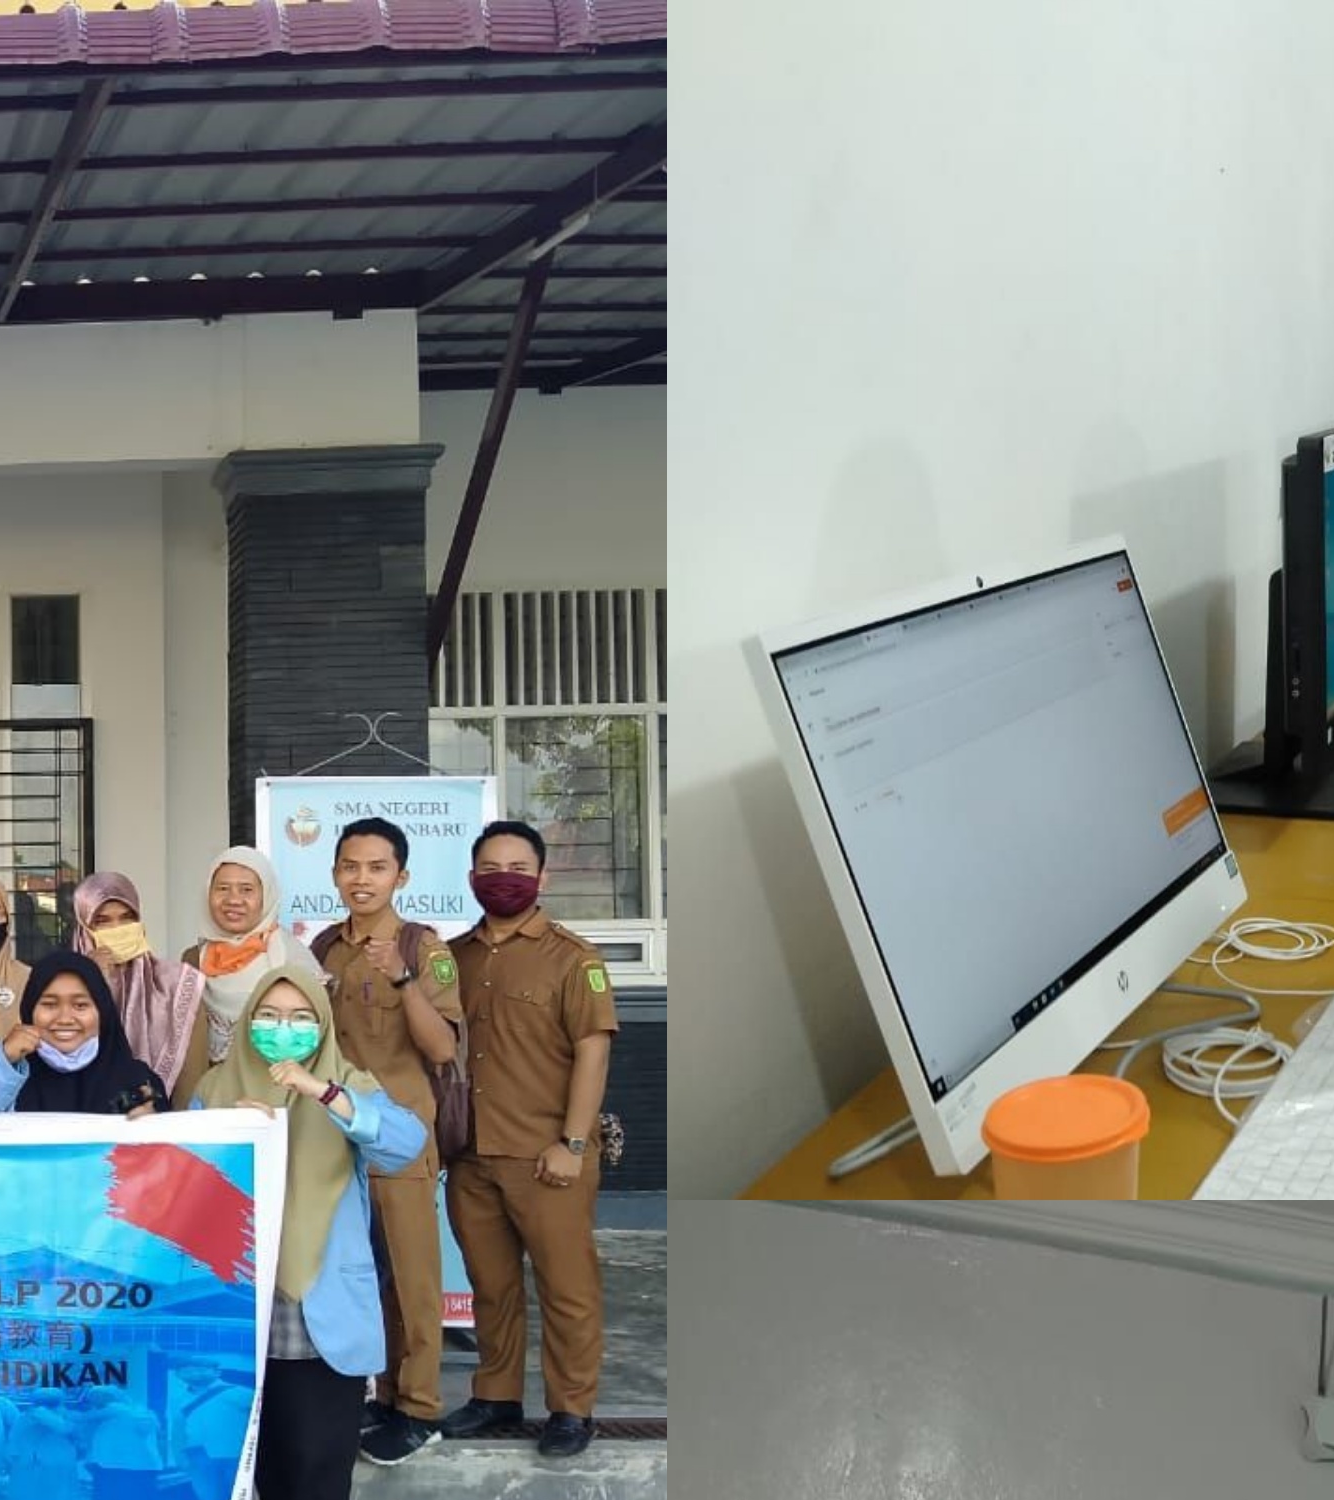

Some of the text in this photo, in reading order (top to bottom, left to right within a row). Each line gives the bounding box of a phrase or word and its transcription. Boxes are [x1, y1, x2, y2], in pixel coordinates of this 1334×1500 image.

[333, 801, 450, 816] SMA NEGERI
[56, 1281, 153, 1310] 2020
